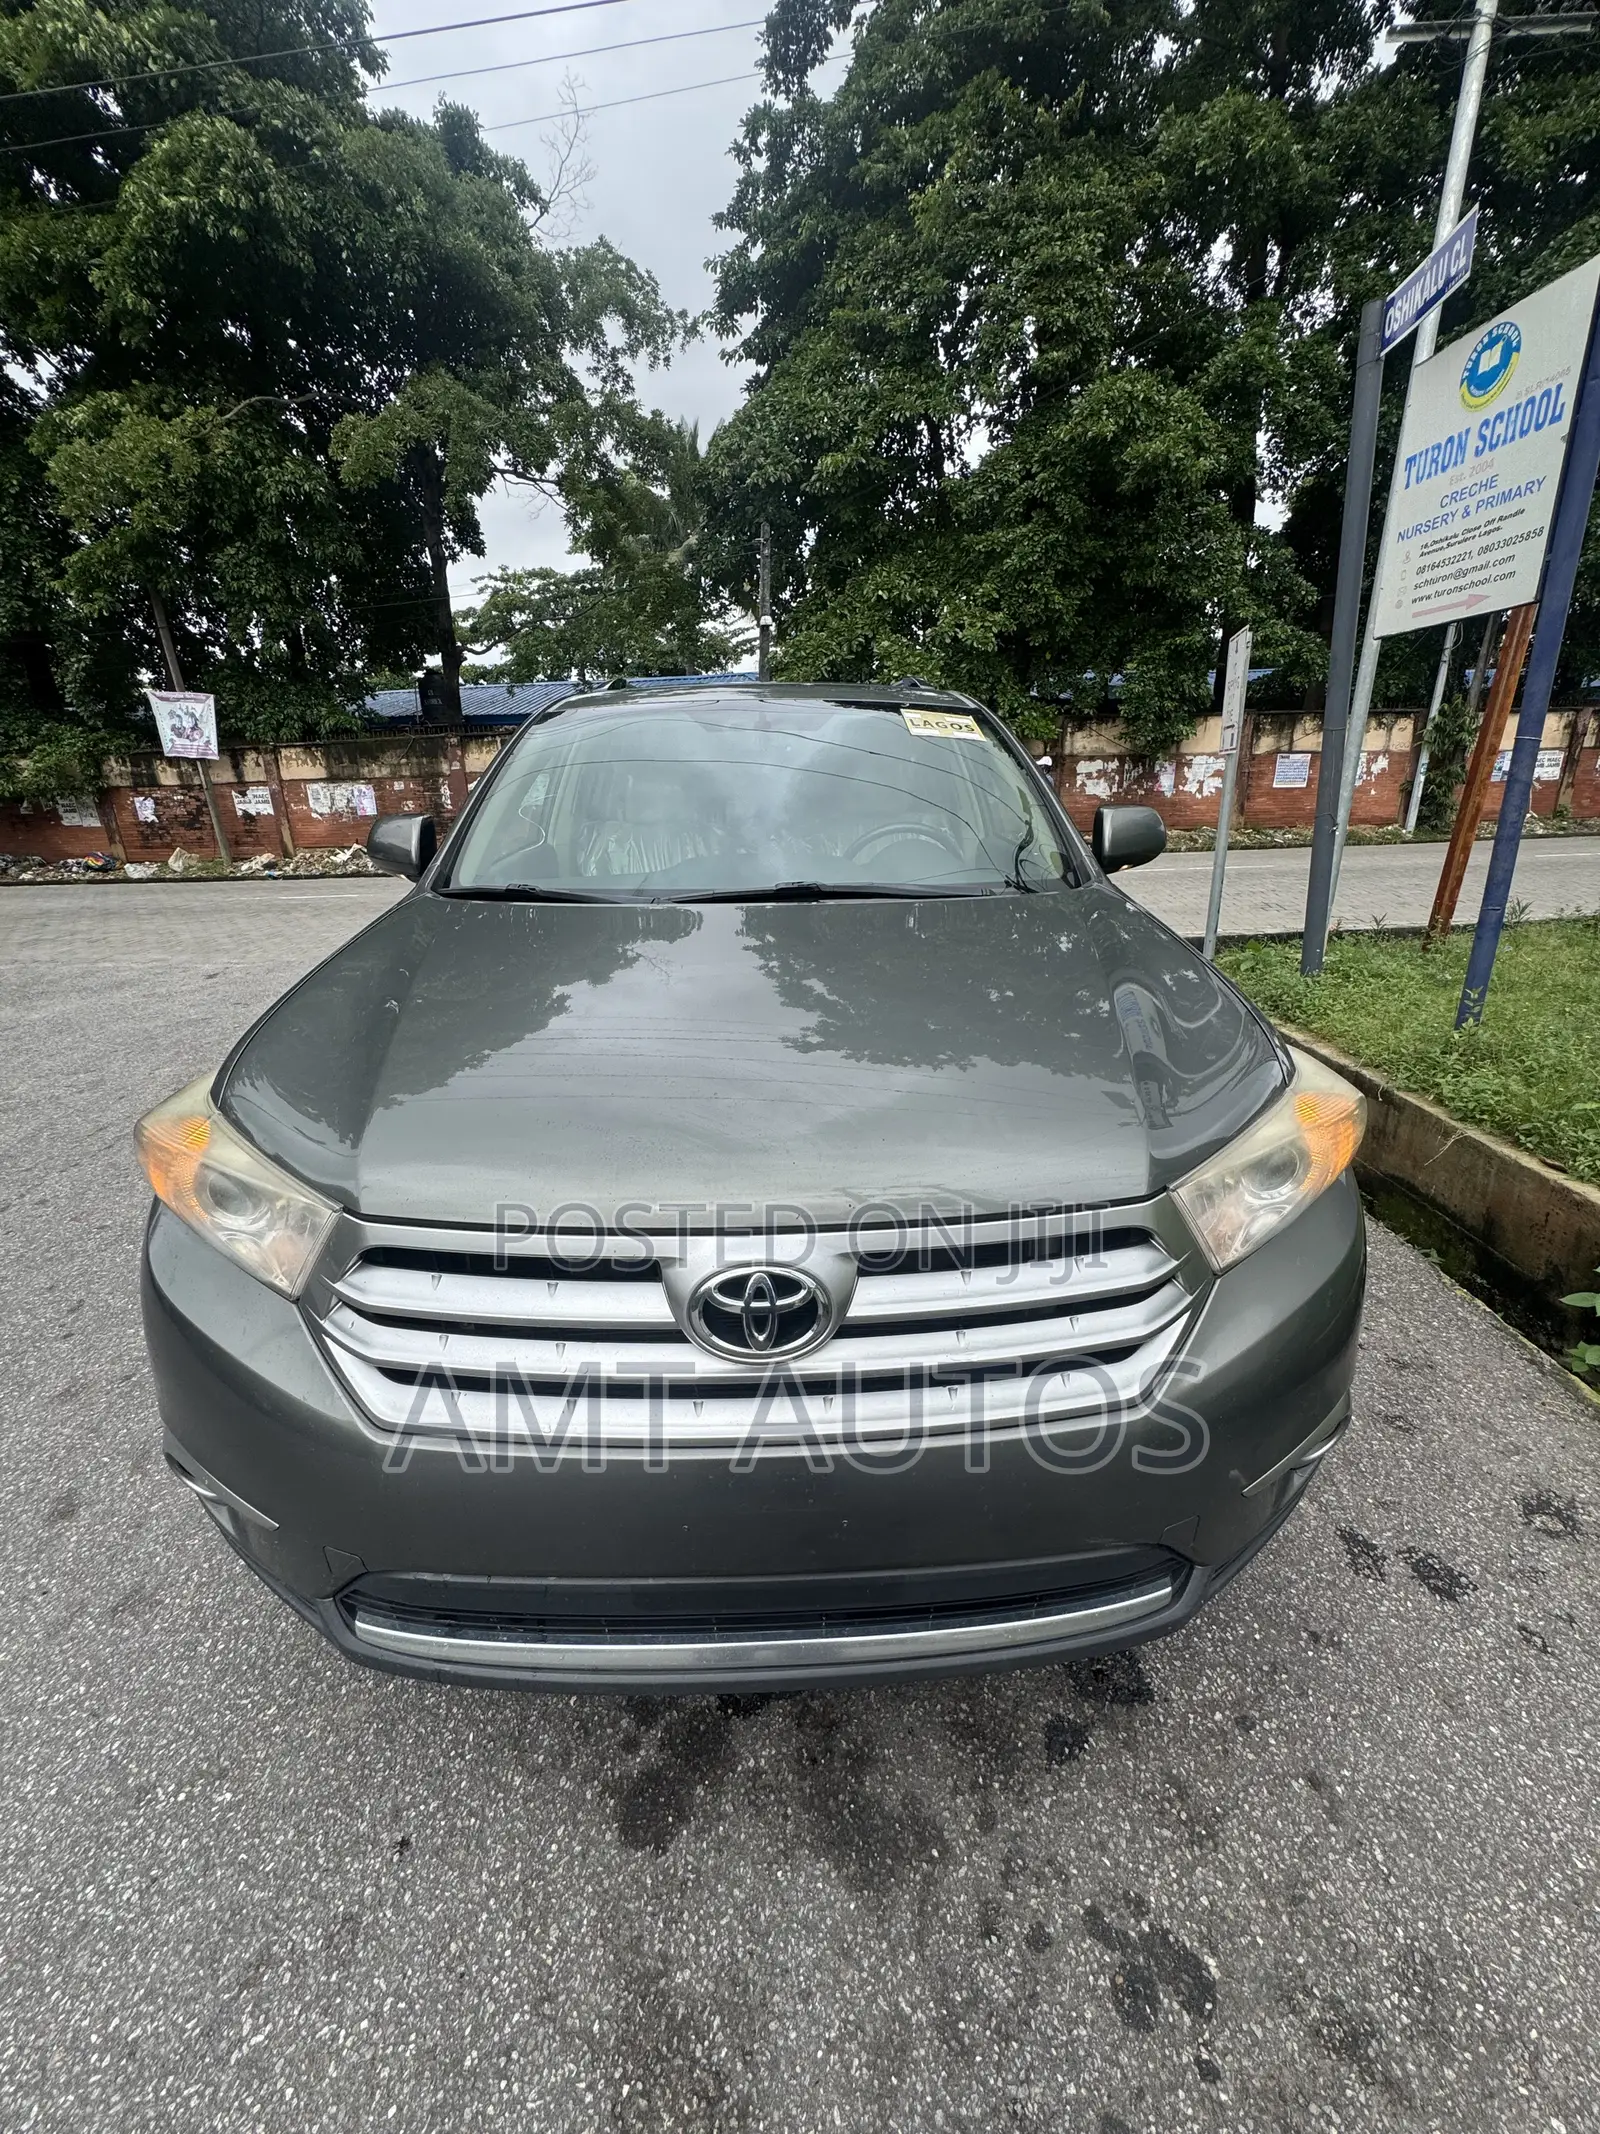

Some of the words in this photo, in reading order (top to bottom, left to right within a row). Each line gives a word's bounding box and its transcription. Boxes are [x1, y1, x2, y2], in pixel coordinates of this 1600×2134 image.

[1384, 252, 1449, 339] OSHIKALU
[1450, 234, 1467, 276] CL
[1462, 335, 1489, 379] TURON
[1491, 323, 1521, 348] SCHOOL
[1404, 426, 1471, 490] TURON
[1474, 382, 1566, 458] SCHOOL
[1449, 472, 1466, 486] Est.
[1469, 458, 1495, 478] 2004
[1440, 474, 1499, 508] CRECHE
[1396, 508, 1459, 543] NURSERY
[1461, 505, 1471, 519] &
[1475, 475, 1547, 514] PRIMARY
[1461, 525, 1482, 536] Close
[1483, 518, 1497, 528] Off
[1497, 508, 1526, 523] Randle
[1477, 526, 1545, 557] 08033025858
[1411, 570, 1516, 605] www.turonschool.com
[1413, 553, 1516, 590] schturon@gmail.com
[909, 718, 975, 732] LAGOS
